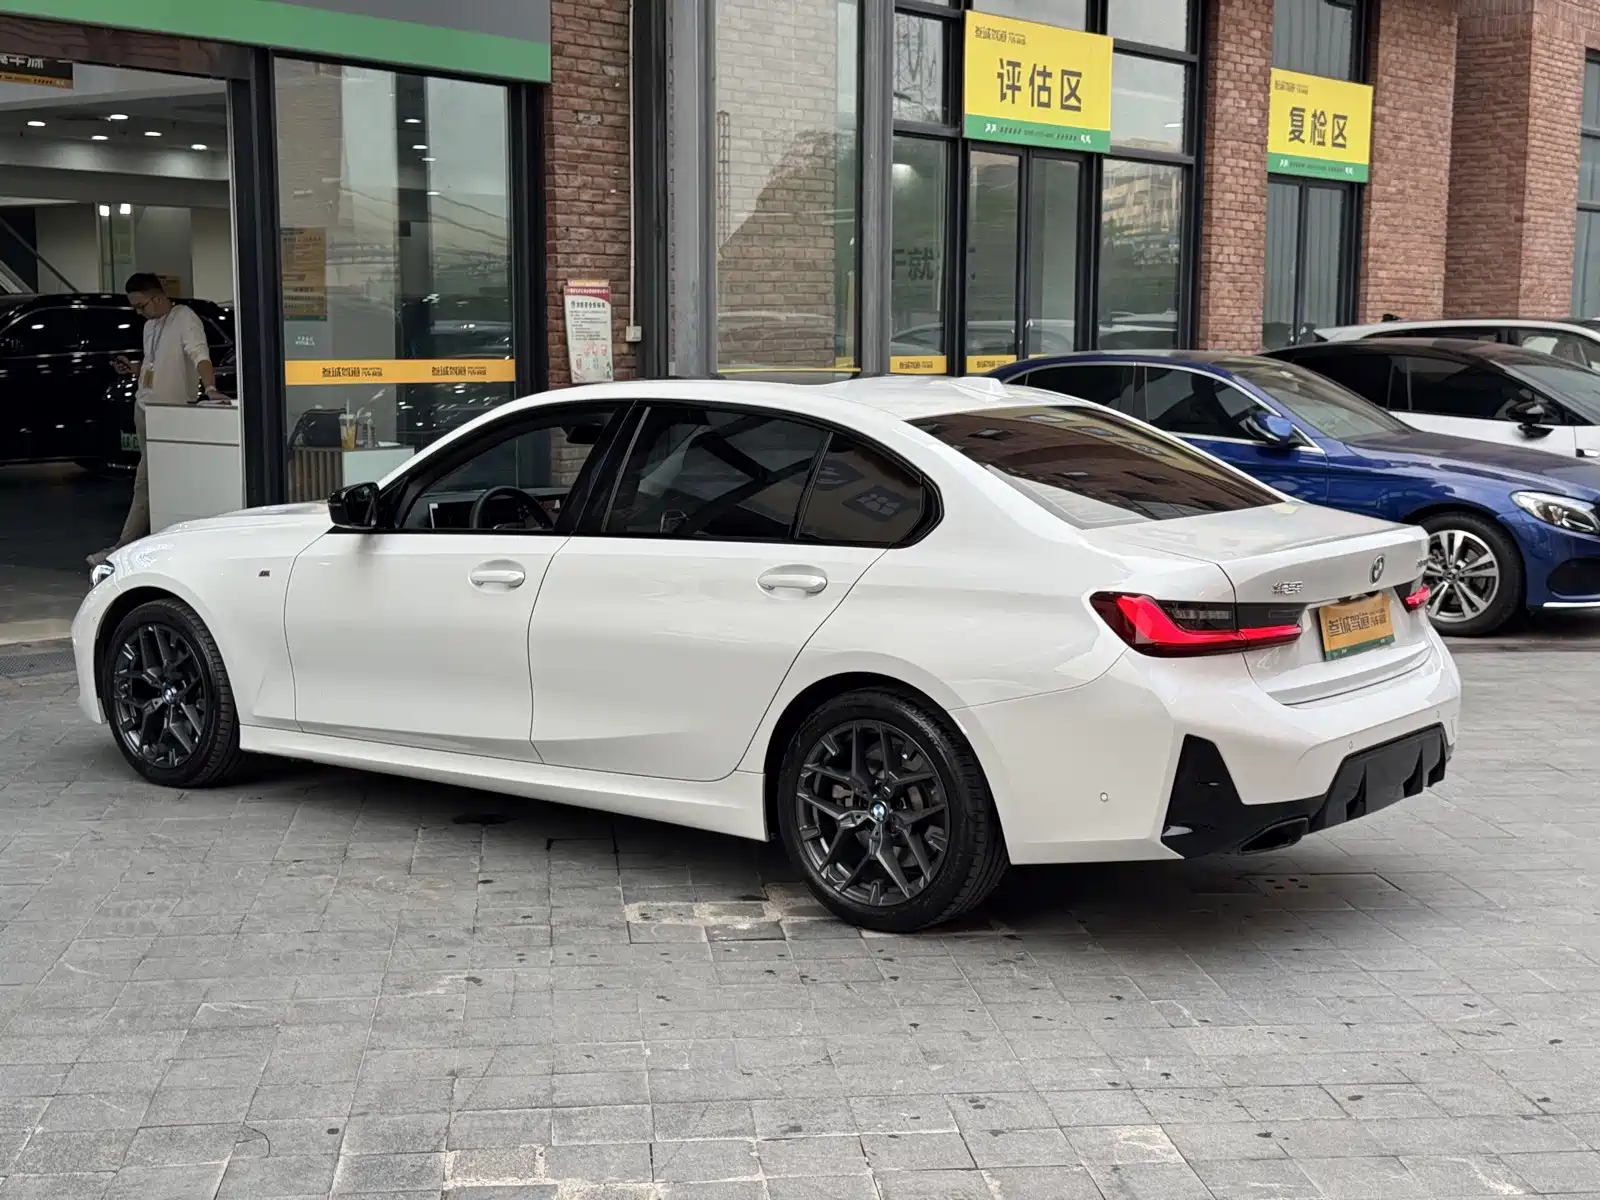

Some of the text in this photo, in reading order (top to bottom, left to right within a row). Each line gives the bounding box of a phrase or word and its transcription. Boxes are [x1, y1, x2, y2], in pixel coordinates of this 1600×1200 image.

[997, 58, 1082, 112] 评估区
[1288, 106, 1348, 149] 复检区
